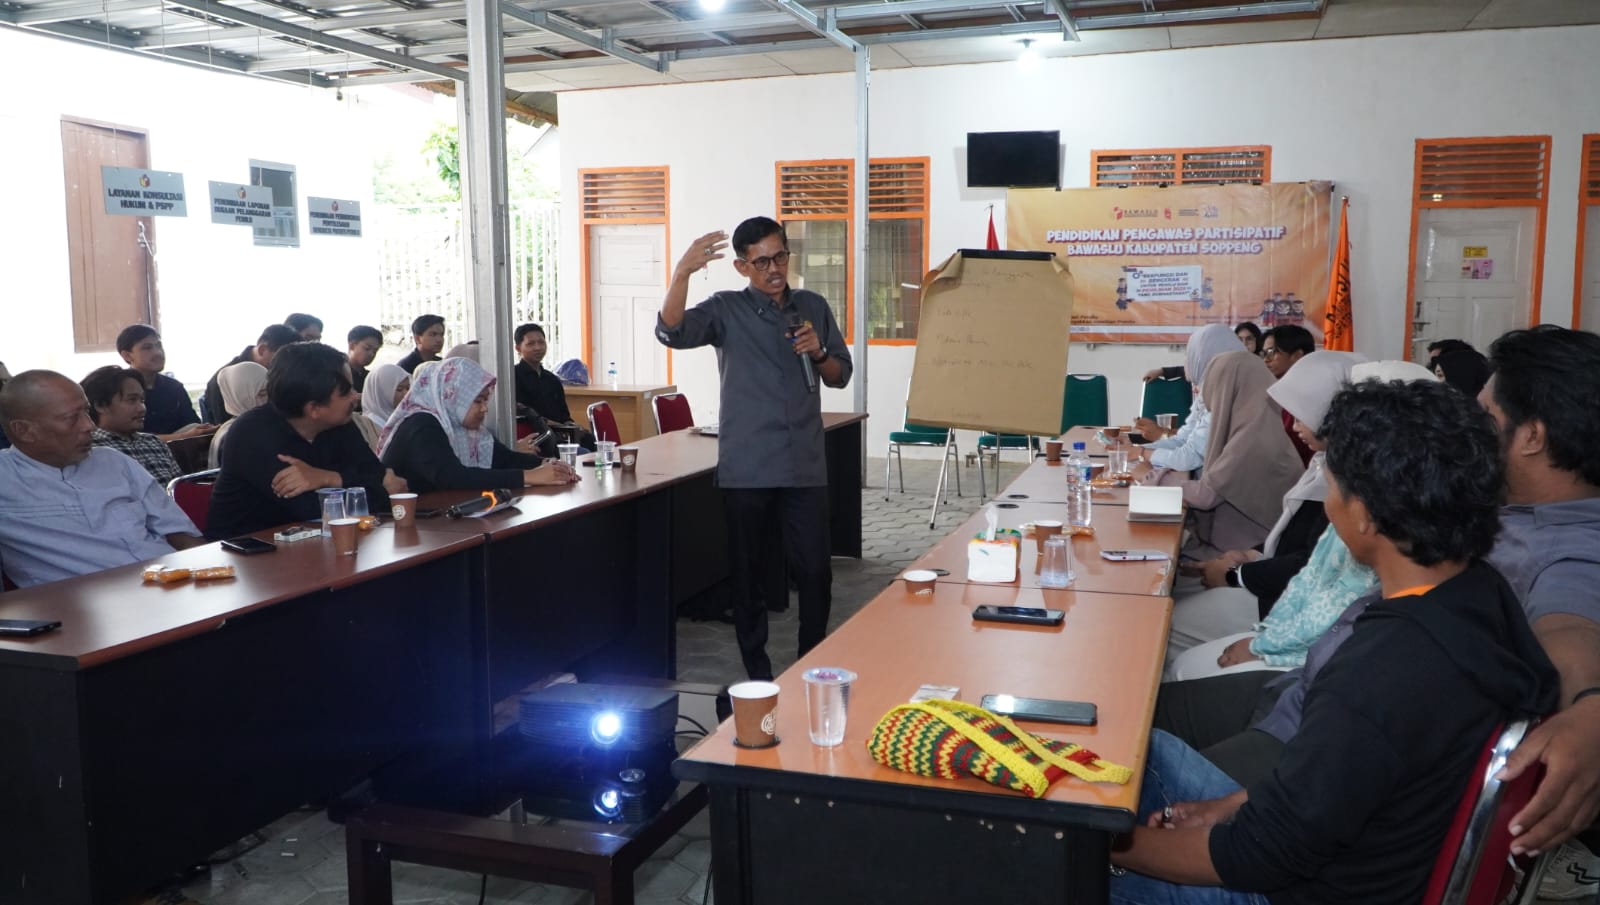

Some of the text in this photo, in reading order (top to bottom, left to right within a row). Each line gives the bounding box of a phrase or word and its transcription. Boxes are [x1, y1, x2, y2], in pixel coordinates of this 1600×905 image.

[108, 188, 183, 201] LAYANAN KONSULTASI
[120, 200, 146, 209] HUKUM
[148, 202, 154, 210] &
[1046, 226, 1286, 242] PENDIDIKAN PENGAWAS PARTISIPATIF
[1067, 241, 1263, 256] BAWASLU KABUPATEN SOPPENG
